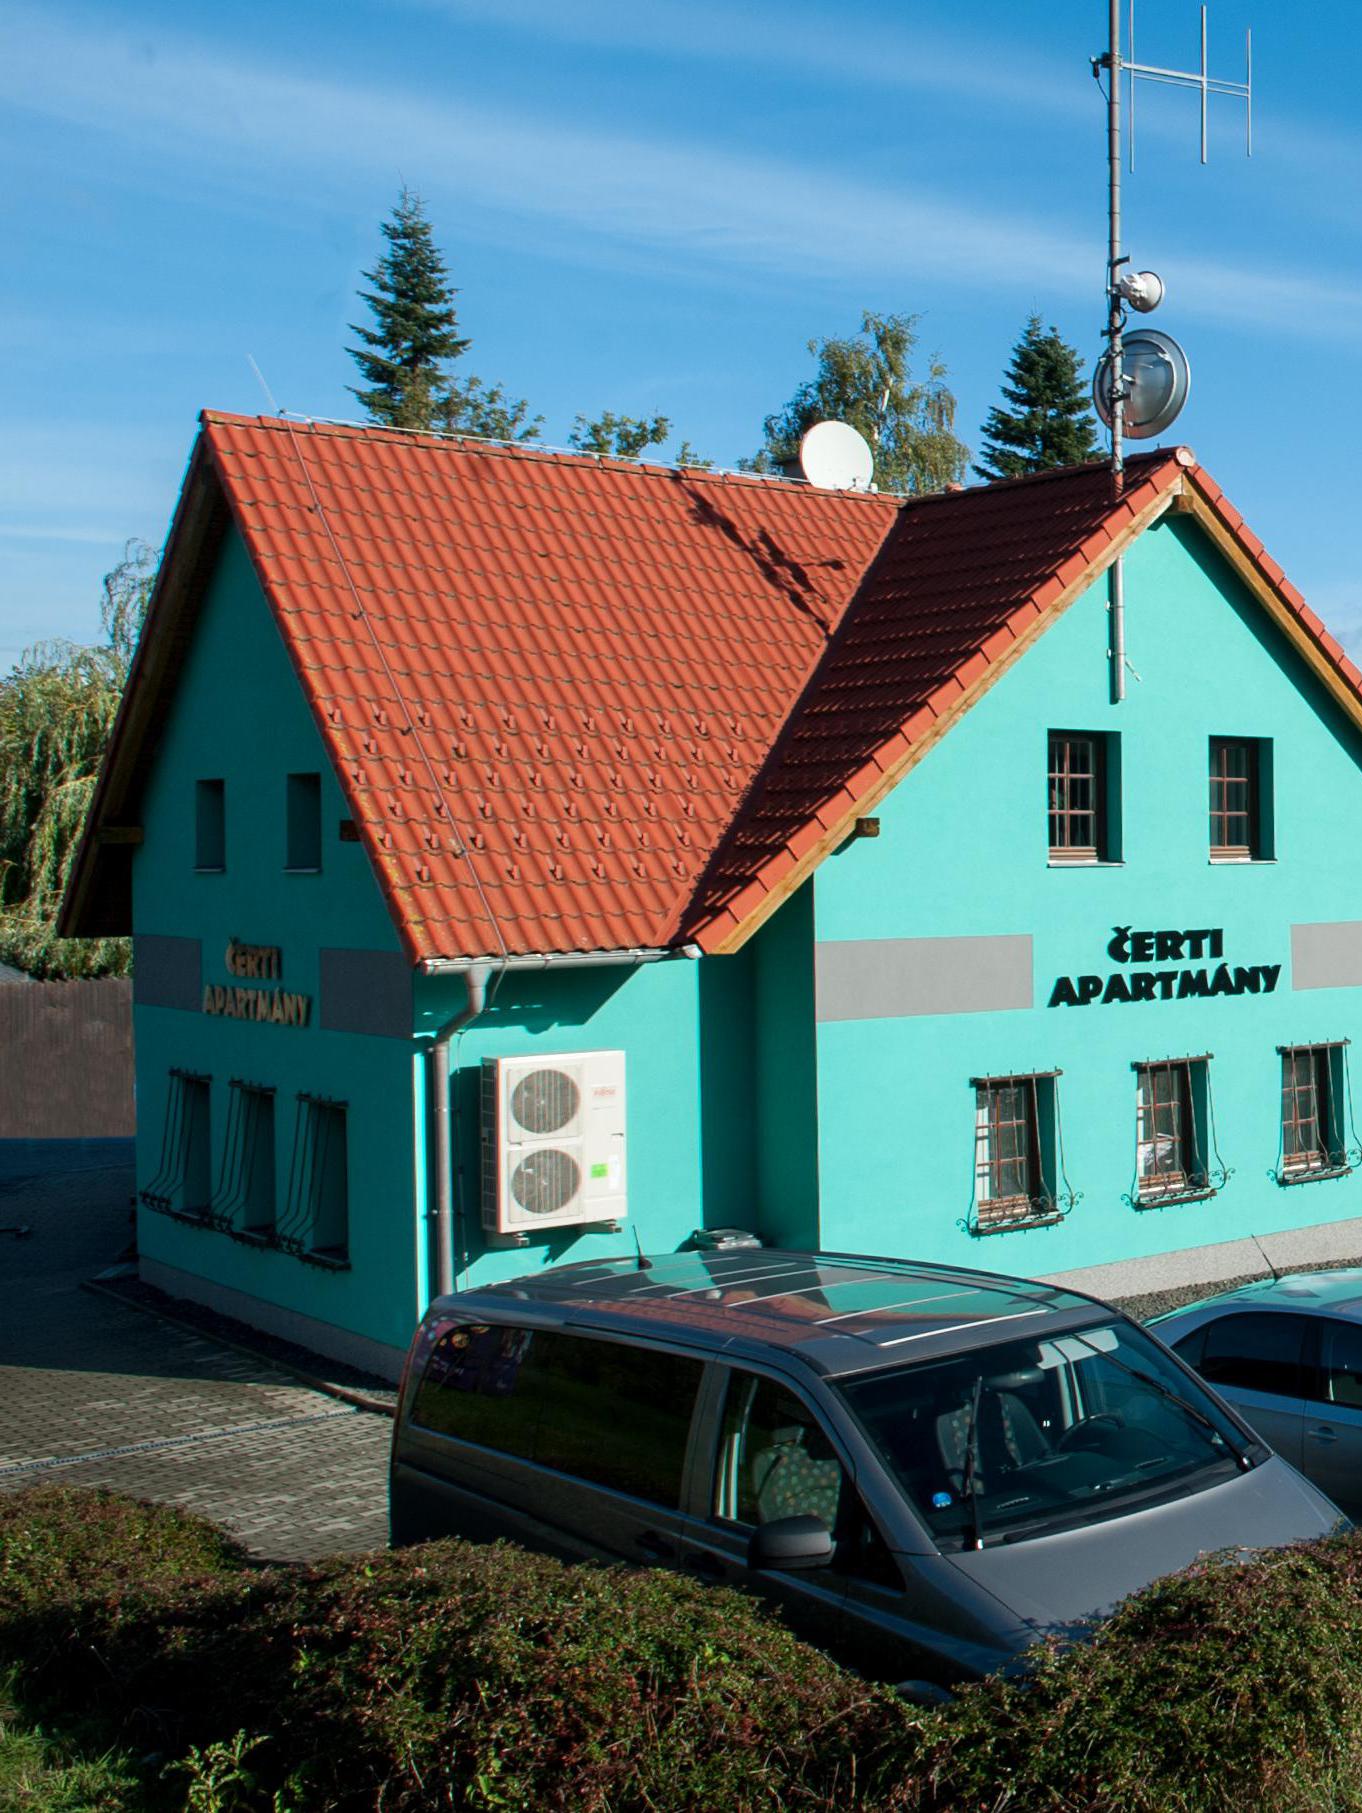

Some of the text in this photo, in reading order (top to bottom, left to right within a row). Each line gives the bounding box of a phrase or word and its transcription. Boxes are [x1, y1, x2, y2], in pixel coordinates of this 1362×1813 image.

[225, 936, 282, 980] ČERTI
[1107, 926, 1223, 964] ČERTI
[202, 983, 312, 1028] APARTMÁNY
[1047, 963, 1282, 1008] APARTMÁNY
